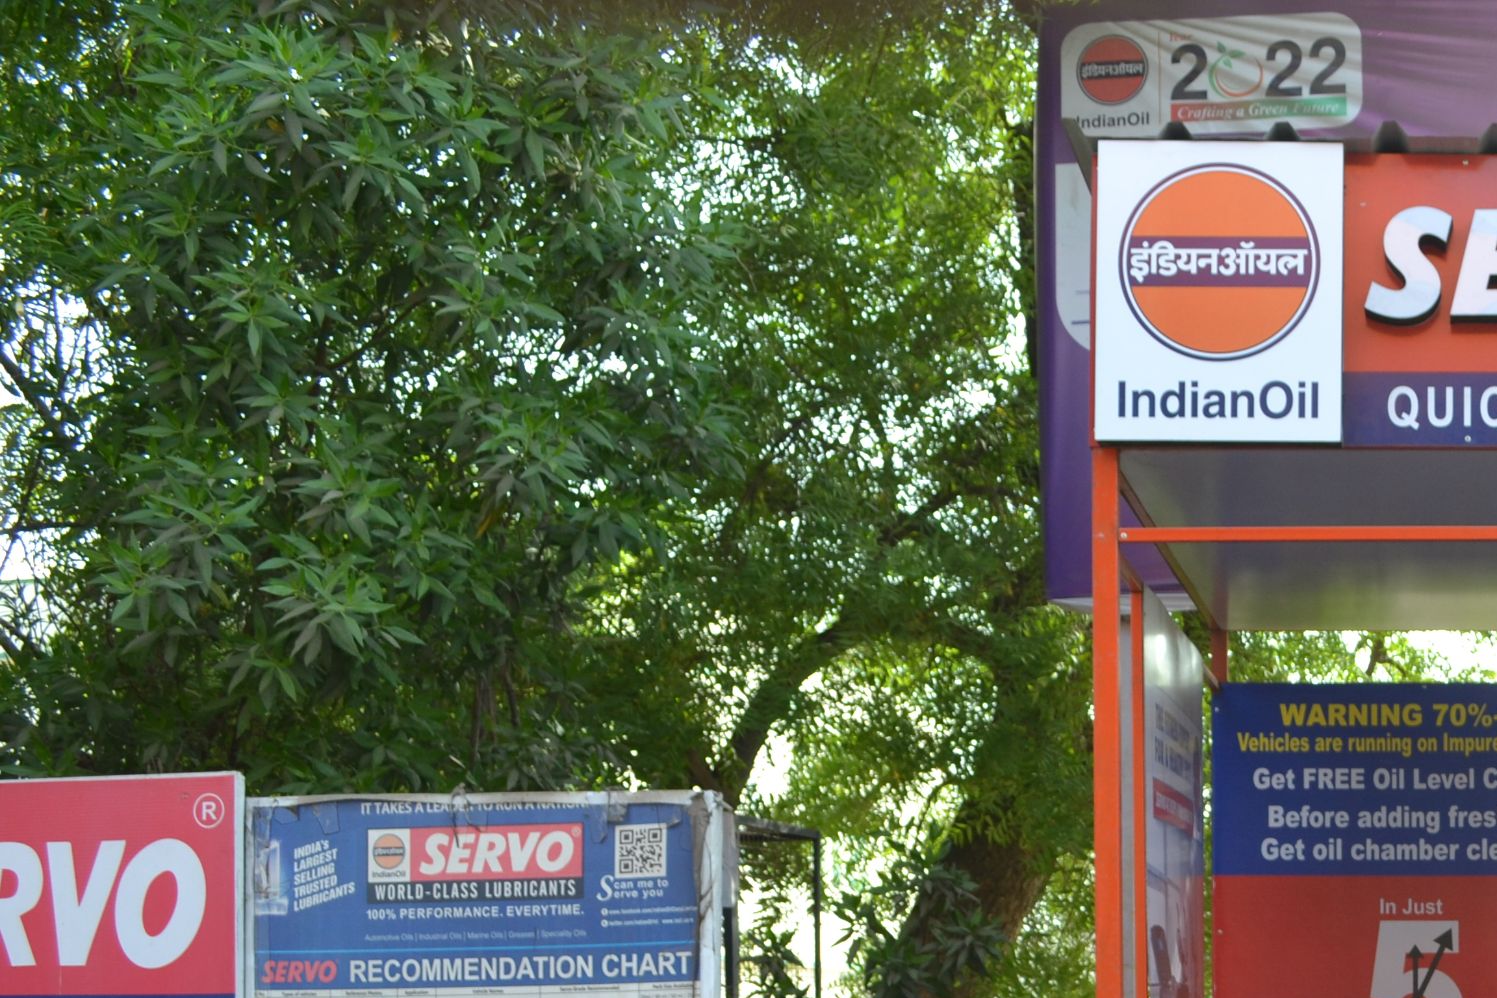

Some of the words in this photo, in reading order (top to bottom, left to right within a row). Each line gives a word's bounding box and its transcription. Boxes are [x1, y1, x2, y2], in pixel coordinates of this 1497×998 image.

[1078, 112, 1151, 129] IndianOil
[1177, 103, 1233, 120] Crafting
[1249, 102, 1288, 117] Green
[1130, 241, 1308, 283] इंडियनऑयल
[1117, 380, 1320, 420] IndianOil
[1279, 703, 1423, 727] WARNING
[1237, 732, 1310, 752] Vehicles
[1315, 737, 1343, 752] are
[1348, 734, 1412, 757] running
[1417, 737, 1438, 752] on
[1253, 768, 1295, 790] Get
[1303, 768, 1365, 790] FREE
[1373, 768, 1405, 790] Oil
[1413, 768, 1476, 790] Level
[1268, 805, 1349, 828] Before
[1357, 805, 1441, 834] adding
[294, 848, 337, 872] LARGEST
[419, 830, 575, 876] SERVO
[1261, 838, 1306, 861] Get
[1312, 837, 1343, 861] oil
[1350, 838, 1459, 861] chamber
[294, 863, 335, 885] SELLING
[637, 880, 654, 889] me
[657, 878, 669, 888] to
[294, 875, 338, 898] TRUSTED
[294, 881, 356, 911] LUBRICANTS
[374, 882, 478, 900] WORLD-CLASS
[485, 879, 576, 898] LUBRICANTS
[642, 888, 664, 899] you
[366, 908, 397, 920] 100%
[506, 903, 584, 917] EVERYTIME.
[1379, 898, 1397, 915] In
[1402, 898, 1443, 915] Just
[261, 959, 337, 984] SERVO
[350, 955, 594, 983] RECOMMENDATION
[602, 951, 693, 978] CHART
